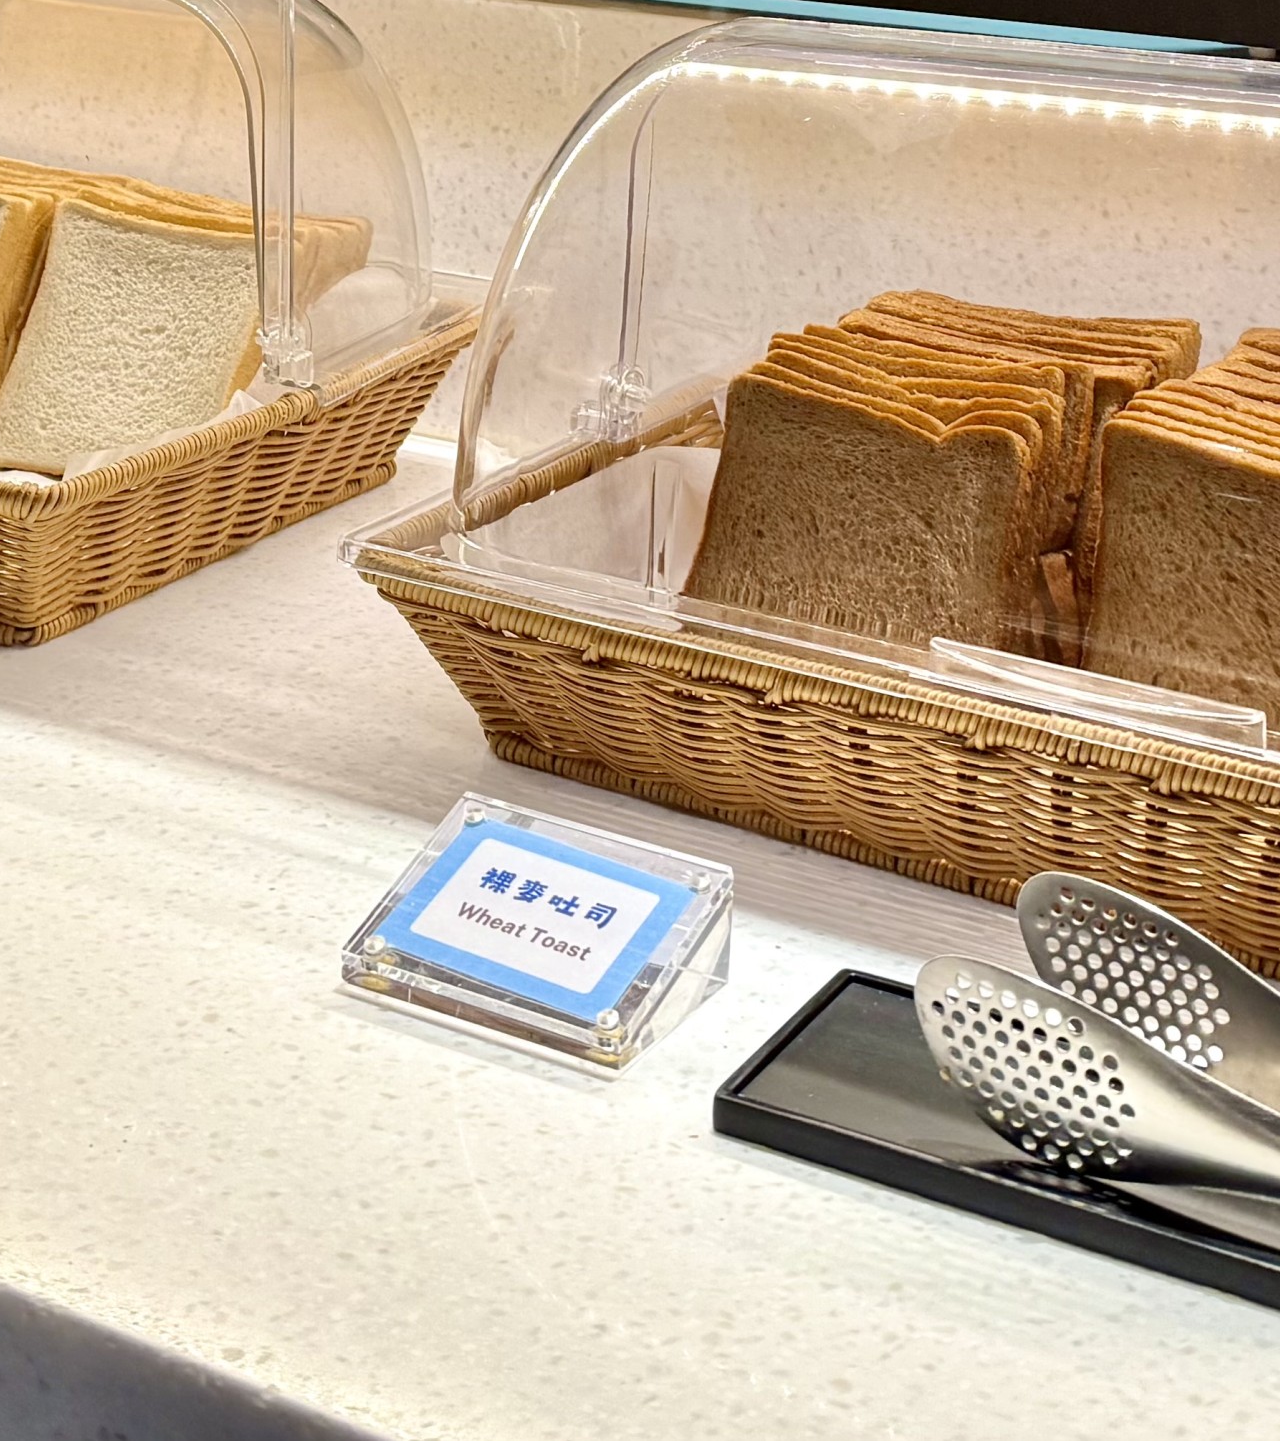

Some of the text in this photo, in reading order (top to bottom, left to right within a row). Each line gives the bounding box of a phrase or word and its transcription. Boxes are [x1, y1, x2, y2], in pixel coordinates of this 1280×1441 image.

[479, 867, 618, 930] 裸麥吐司
[457, 901, 591, 961] Wheat Toast
